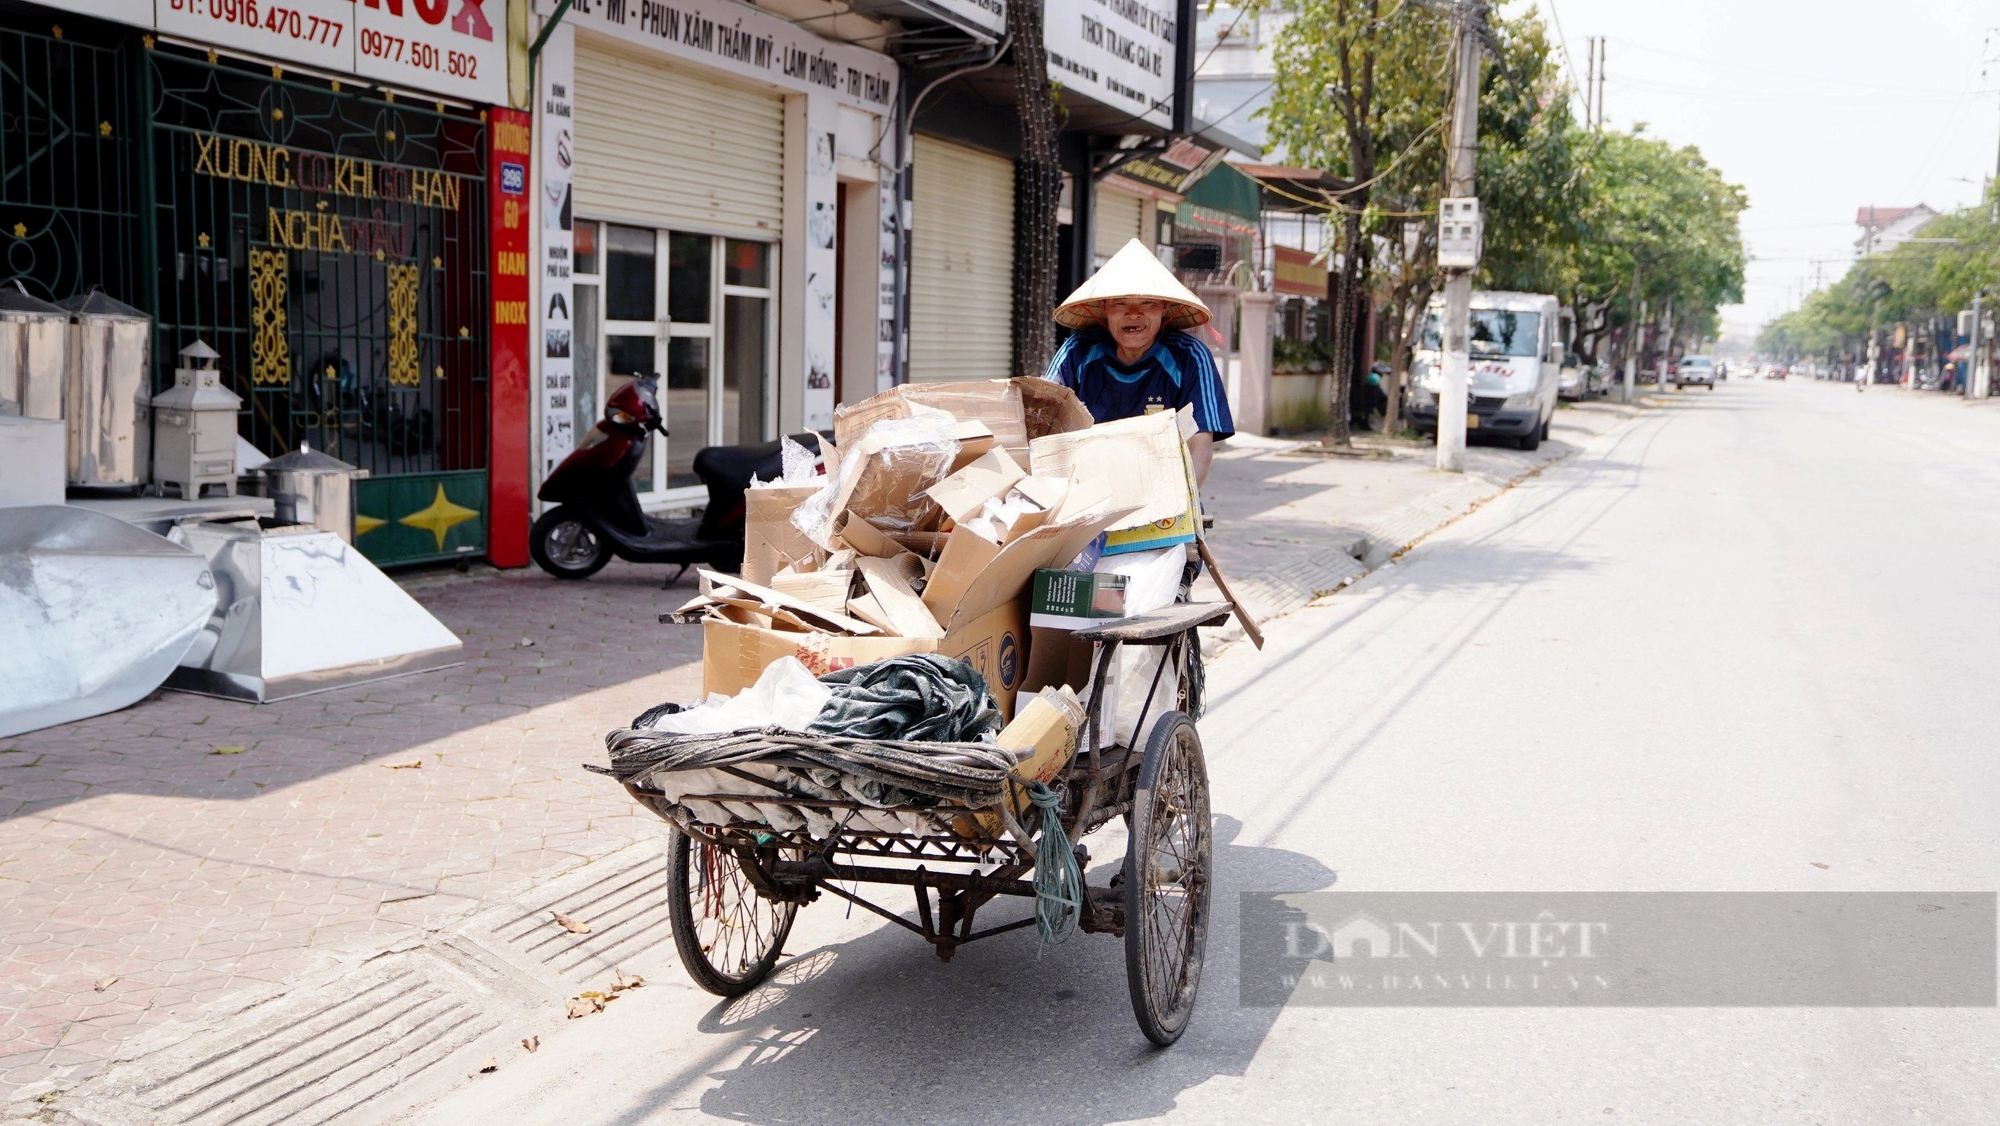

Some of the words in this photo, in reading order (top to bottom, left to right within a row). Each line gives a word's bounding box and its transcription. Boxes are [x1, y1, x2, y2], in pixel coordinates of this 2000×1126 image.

[209, 0, 343, 47] 0916.470.777
[641, 0, 680, 42] PHUN
[683, 10, 713, 52] XĂM
[361, 28, 477, 80] 0977.501.502
[498, 241, 526, 276] HÀN
[495, 300, 527, 324] INOX
